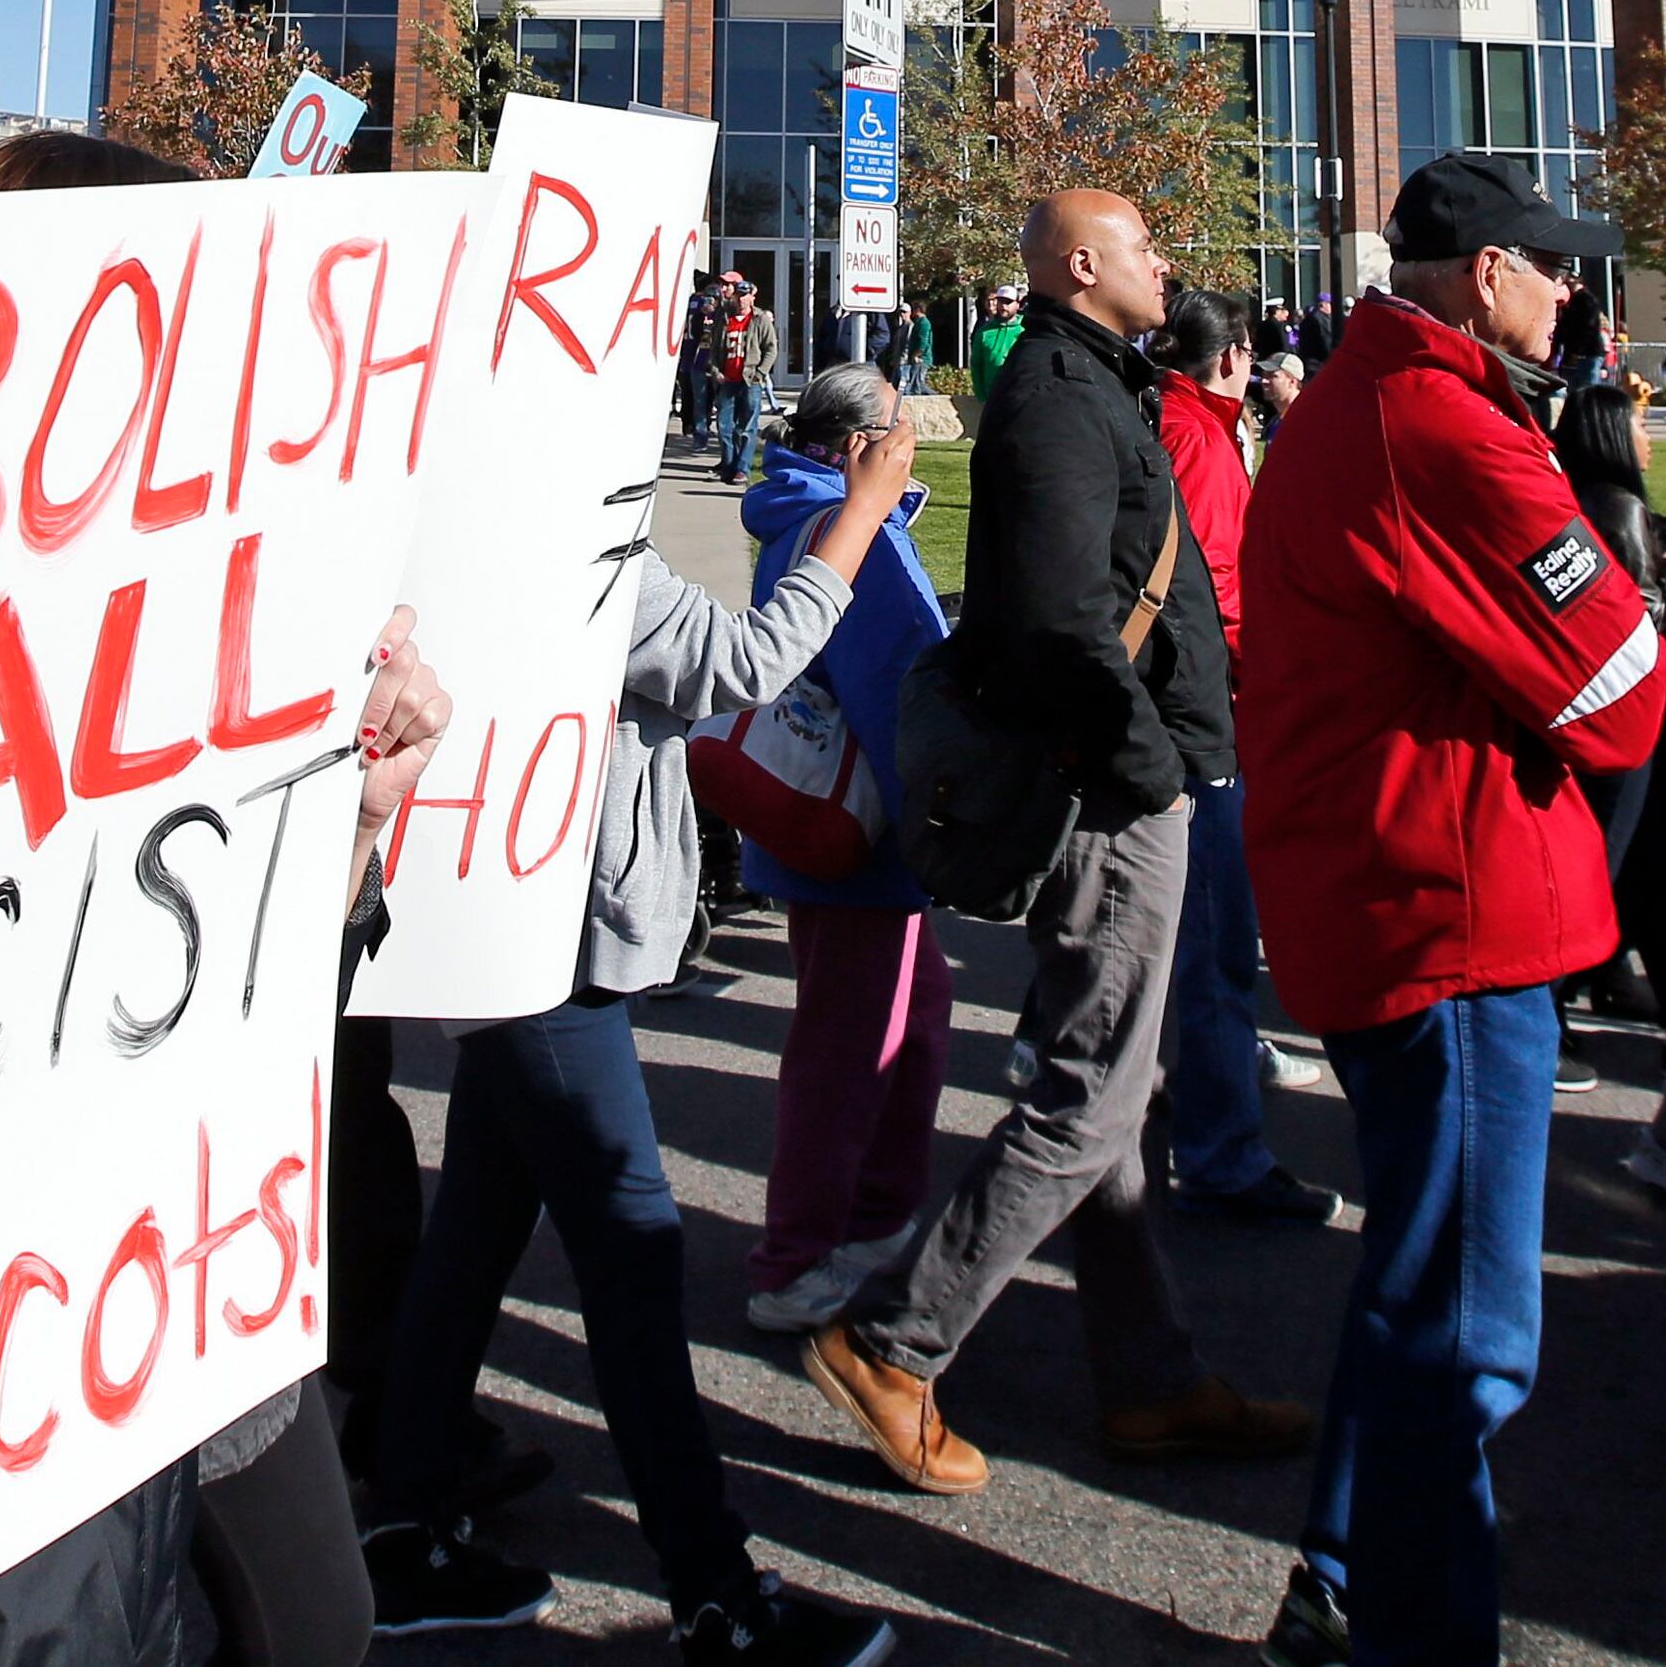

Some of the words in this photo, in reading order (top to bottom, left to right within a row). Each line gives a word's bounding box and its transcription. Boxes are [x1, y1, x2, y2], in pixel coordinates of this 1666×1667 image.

[845, 66, 860, 85] NO
[863, 71, 895, 88] PARKING
[857, 219, 882, 245] NO
[846, 252, 892, 273] PARKING
[1533, 536, 1581, 581] Edina
